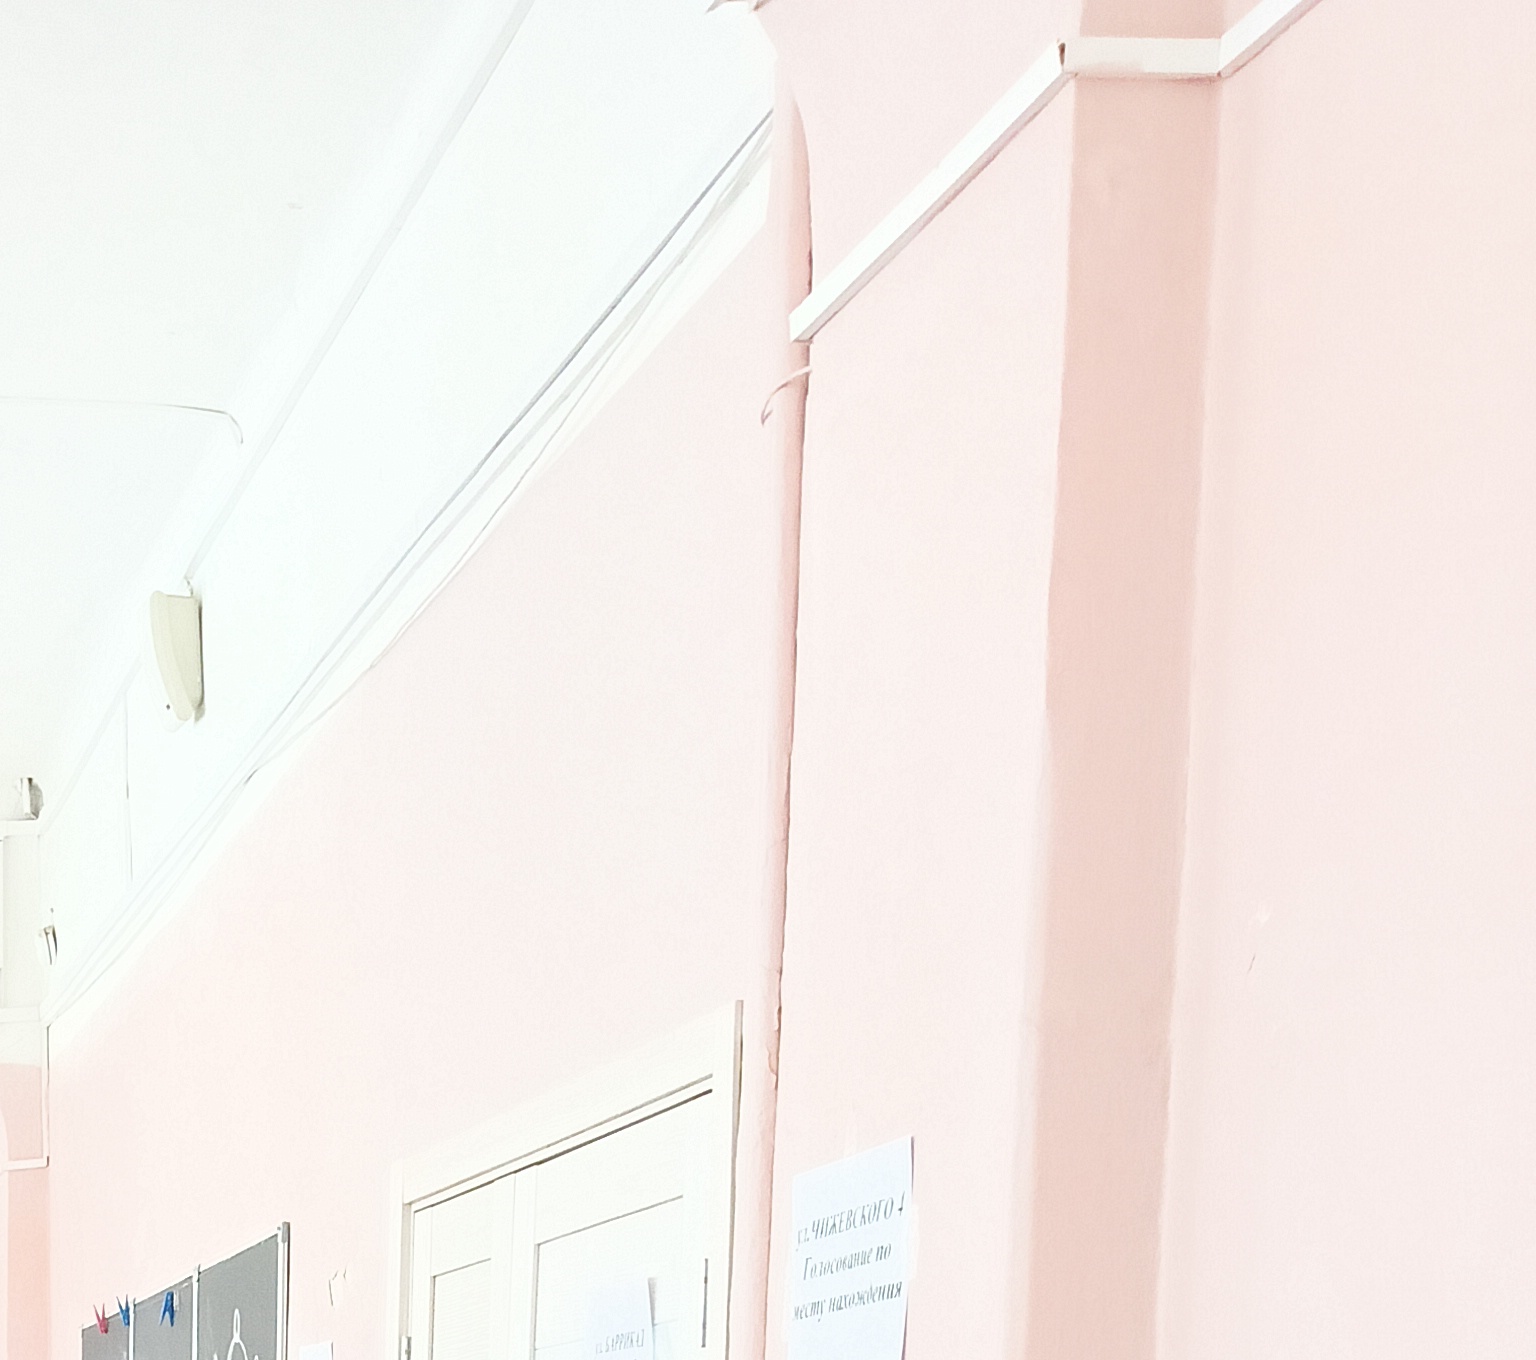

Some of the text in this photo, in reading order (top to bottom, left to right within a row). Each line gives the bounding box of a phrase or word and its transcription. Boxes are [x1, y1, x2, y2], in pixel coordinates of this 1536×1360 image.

[811, 1197, 894, 1240] ЧИЖЕВСКОГО
[803, 1243, 892, 1281] Голосование по
[792, 1280, 902, 1322] месту нахождения
